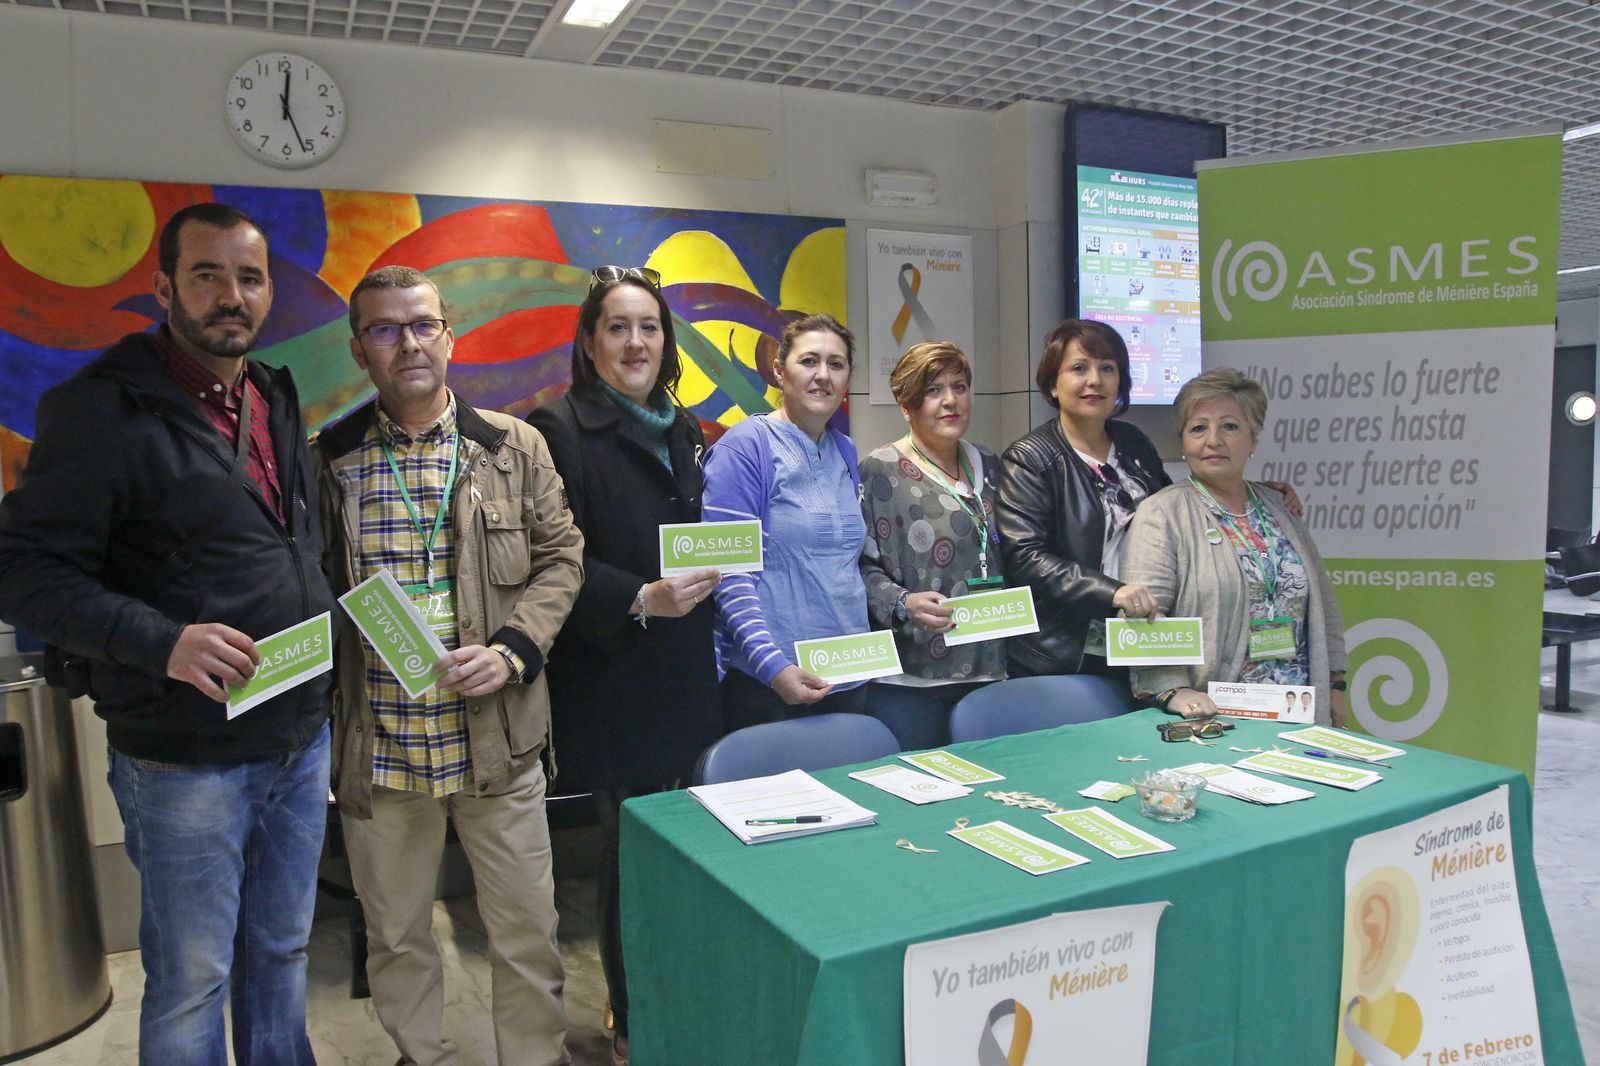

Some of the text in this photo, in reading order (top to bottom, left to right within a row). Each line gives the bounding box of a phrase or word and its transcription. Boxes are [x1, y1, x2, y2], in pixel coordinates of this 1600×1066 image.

[258, 64, 268, 76] 11
[278, 60, 291, 72] 12
[241, 77, 252, 90] 10
[318, 84, 328, 96] 2
[236, 98, 246, 110] 9
[326, 105, 335, 117] 3
[243, 120, 252, 132] 8
[320, 126, 330, 137] 4
[260, 136, 269, 147] 7
[305, 139, 314, 151] 5
[282, 144, 292, 156] 6
[1108, 191, 1124, 201] Más
[1125, 193, 1134, 202] de
[1136, 195, 1162, 205] 15.000
[1163, 197, 1178, 207] días
[1108, 205, 1118, 214] de
[1119, 206, 1154, 218] instantes
[1156, 211, 1169, 220] que
[878, 242, 962, 258] Yo también vivo con
[1296, 235, 1539, 288] ASMES
[1292, 280, 1538, 310] Asociación Síndrome de Ménière España
[1300, 362, 1375, 399] sabes
[1382, 360, 1407, 397] lo
[1412, 358, 1500, 405] fuerte
[1273, 404, 1466, 451] que eres hasta
[1314, 459, 1354, 486] ser
[1358, 450, 1442, 495] fuerte
[1450, 457, 1480, 485] es
[1373, 493, 1476, 538] opción"
[696, 536, 753, 549] ASMES
[972, 601, 1025, 620] ASMES
[361, 594, 411, 654] ASMES
[1139, 632, 1194, 642] ASMES
[261, 634, 322, 671] ASMES
[832, 644, 887, 661] ASMES
[1414, 810, 1504, 856] Síndrome de
[972, 831, 1026, 858] ASMES
[1432, 841, 1507, 882] Ménière
[1476, 884, 1489, 894] del
[1472, 949, 1481, 959] de
[932, 931, 1134, 997] Yo también vivo con
[1050, 962, 1128, 1001] Ménière
[1448, 984, 1495, 1001] Inestabilidad
[1422, 1034, 1533, 1066] 7 de Febrero
